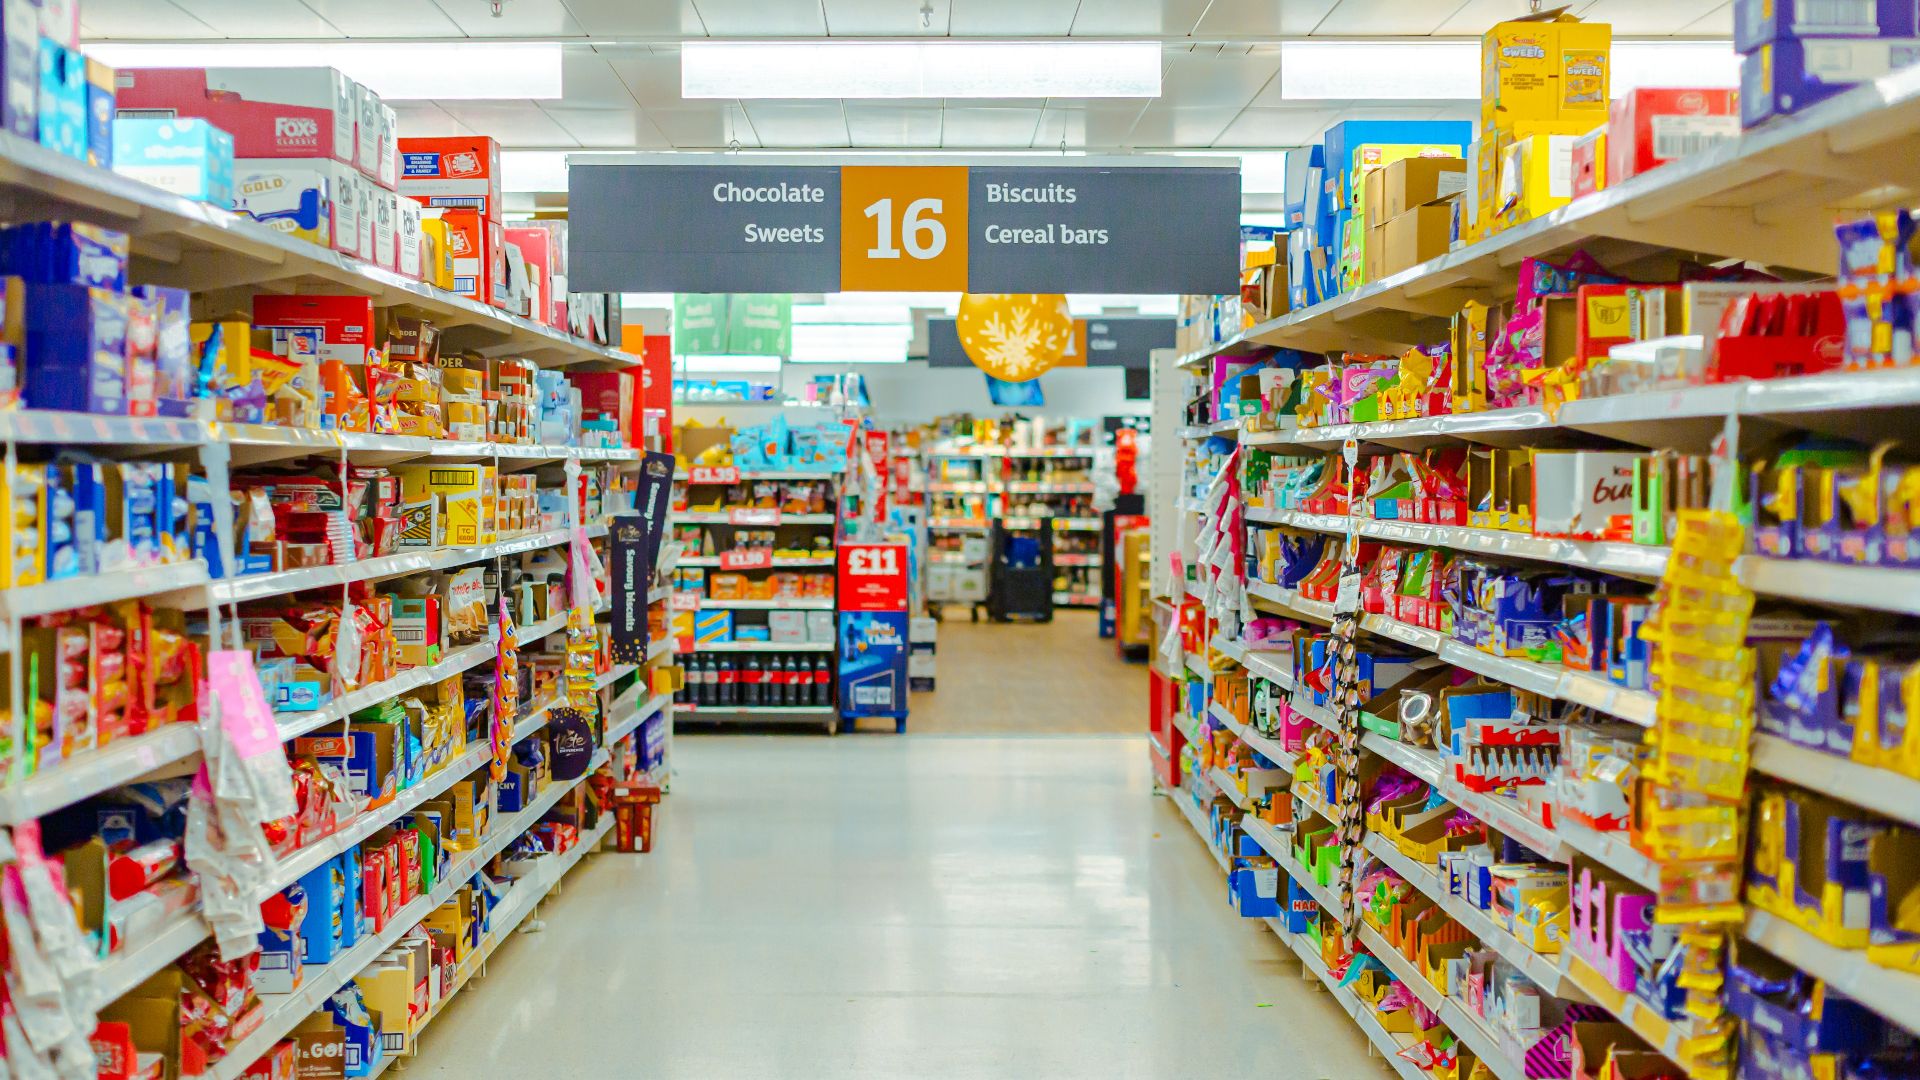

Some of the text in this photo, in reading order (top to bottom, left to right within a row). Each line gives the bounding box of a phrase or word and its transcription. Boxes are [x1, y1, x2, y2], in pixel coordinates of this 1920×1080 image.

[1502, 46, 1545, 58] SWEETS
[1568, 65, 1602, 76] SWEETS
[243, 178, 283, 194] GOLD
[713, 182, 825, 203] Chocolate
[986, 182, 1077, 203] Biscuits
[744, 223, 825, 243] Sweets
[863, 197, 948, 260] 16
[985, 223, 1109, 244] Cereal bars
[624, 549, 635, 590] Savoury
[847, 548, 900, 576] £11
[625, 591, 636, 632] biscuits
[313, 741, 335, 753] CLUB
[554, 732, 586, 754] taste
[311, 1042, 344, 1058] GO!
